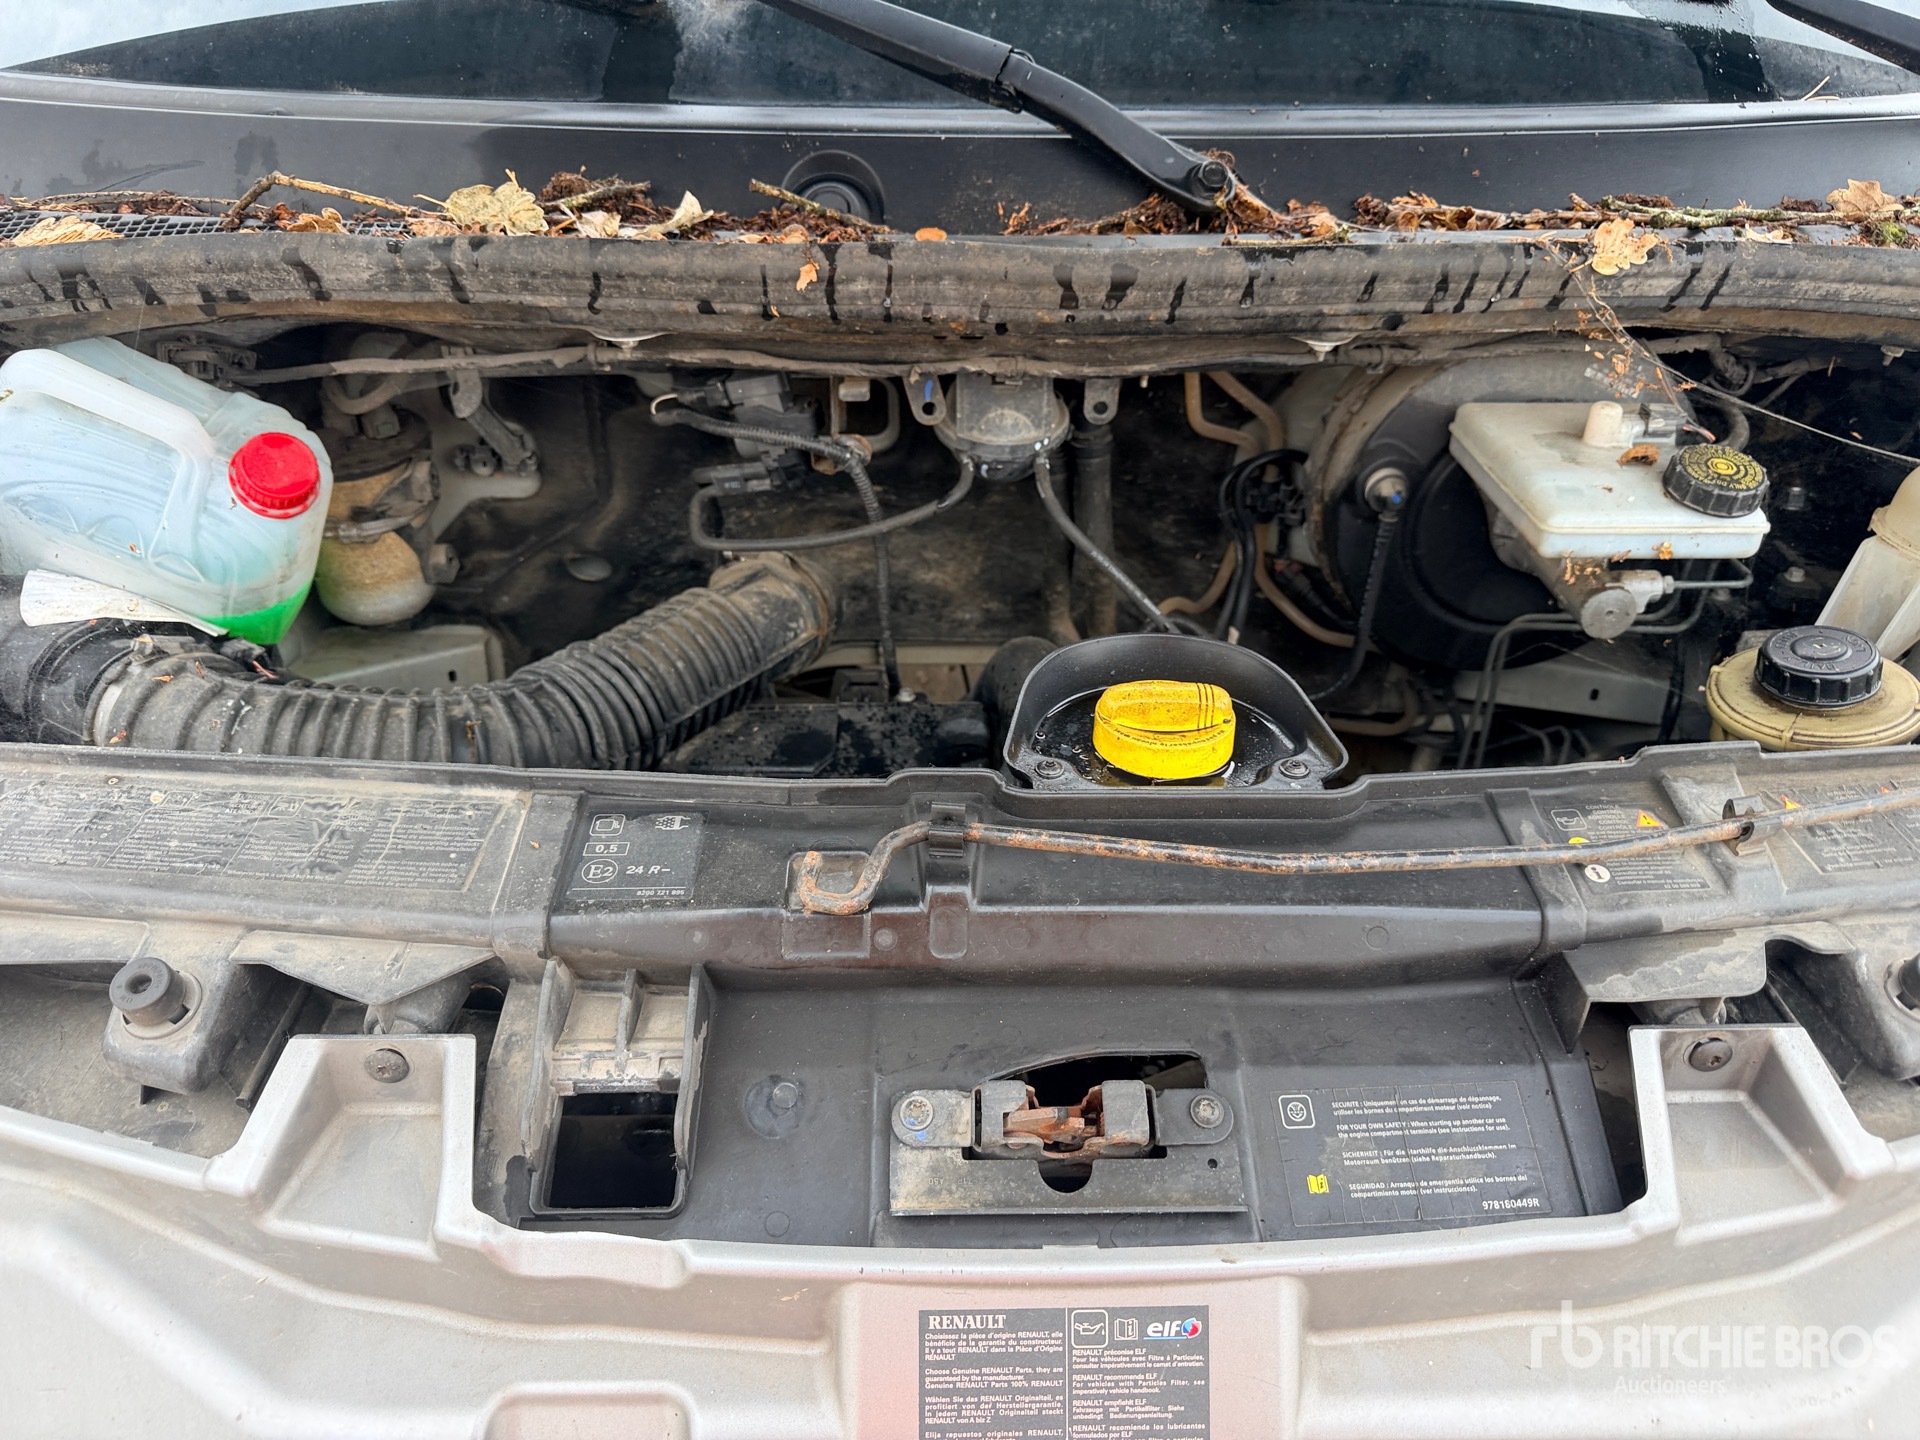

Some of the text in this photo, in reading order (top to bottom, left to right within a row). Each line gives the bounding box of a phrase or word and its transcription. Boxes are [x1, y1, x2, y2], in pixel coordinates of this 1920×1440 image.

[586, 864, 614, 878] E2
[626, 866, 644, 874] 24
[1482, 1198, 1540, 1210] 978180449R
[928, 1315, 1006, 1329] RENAULT
[1146, 1320, 1182, 1337] elf
